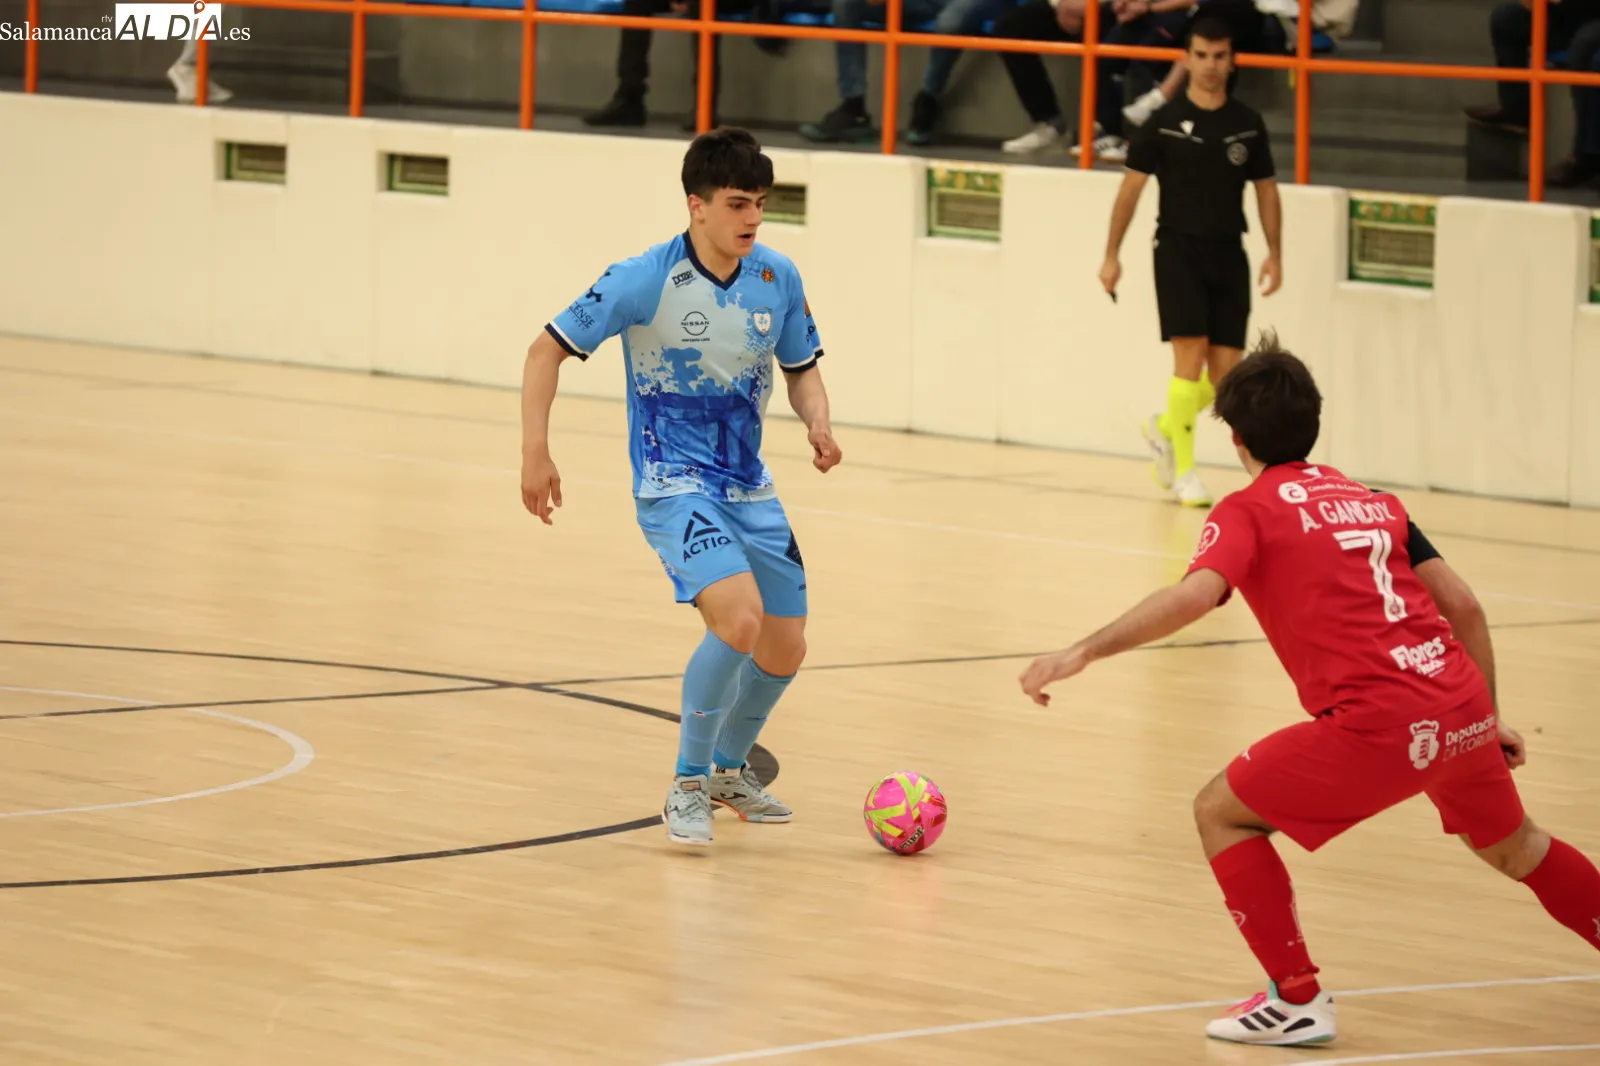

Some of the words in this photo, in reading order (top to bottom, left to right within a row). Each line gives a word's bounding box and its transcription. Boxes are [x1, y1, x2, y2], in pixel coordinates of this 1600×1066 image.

[1298, 506, 1323, 533] A.
[1318, 499, 1396, 524] GANDOY
[1332, 528, 1408, 623] 7
[1389, 636, 1446, 670] Flores
